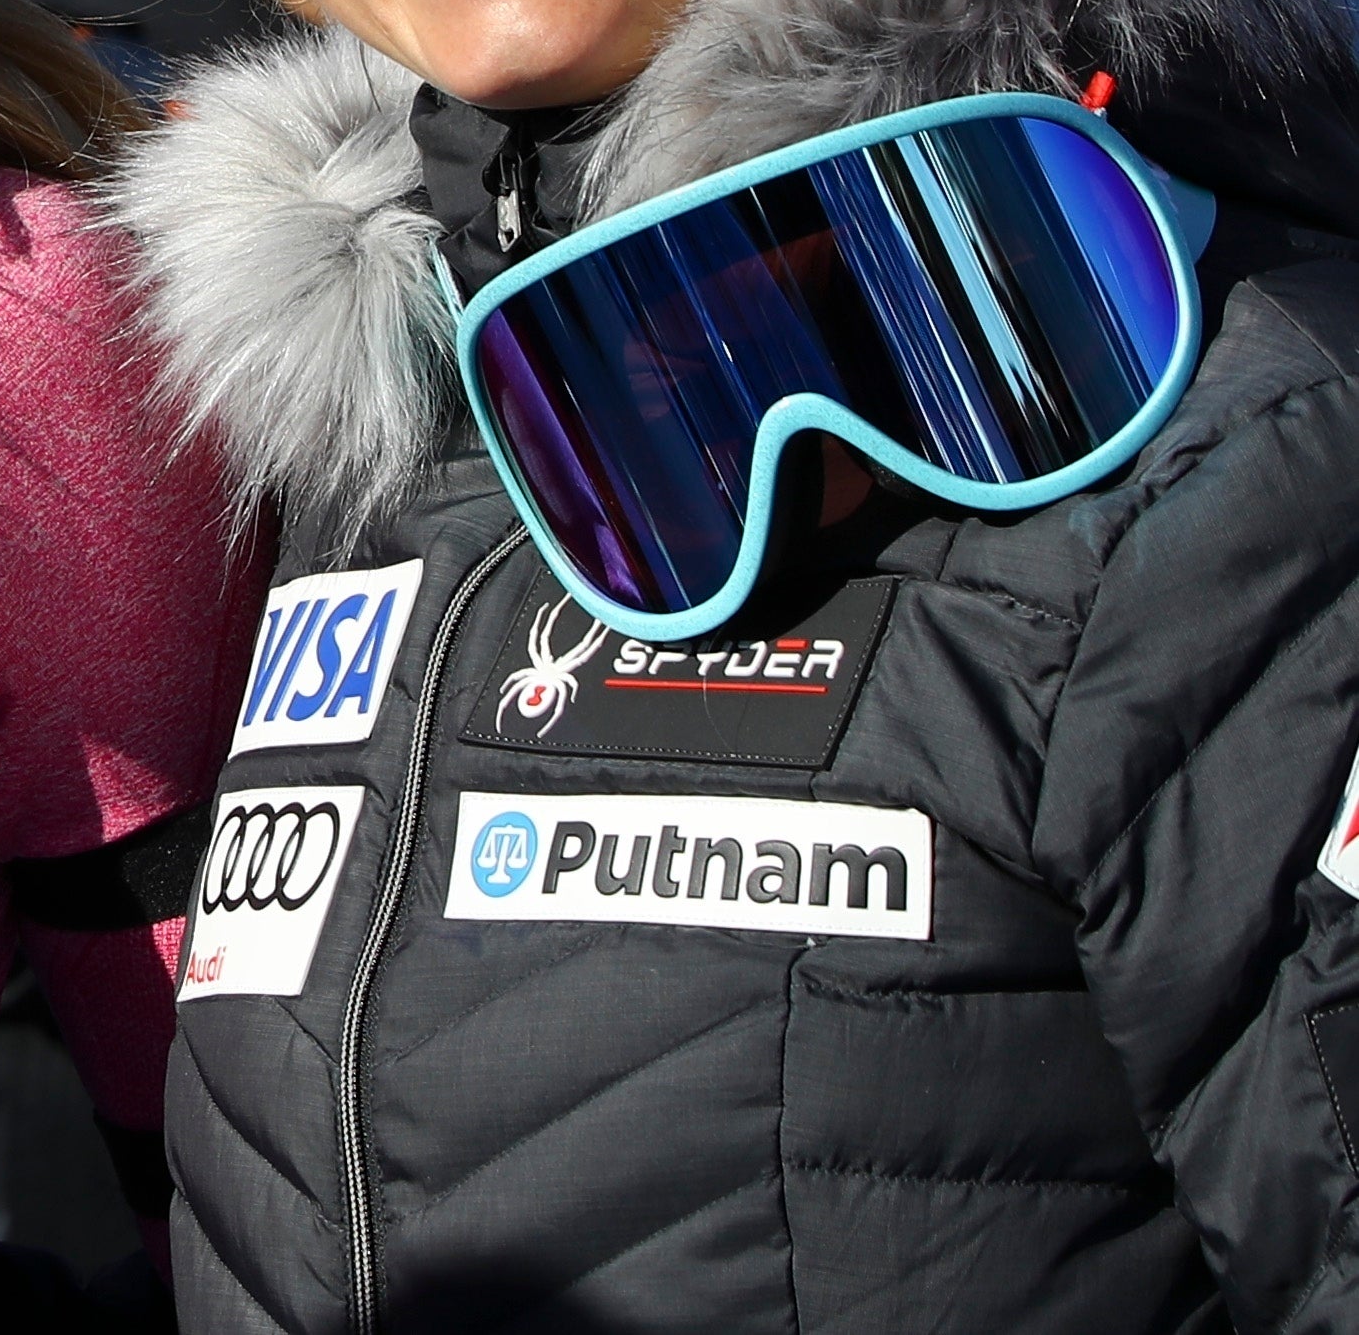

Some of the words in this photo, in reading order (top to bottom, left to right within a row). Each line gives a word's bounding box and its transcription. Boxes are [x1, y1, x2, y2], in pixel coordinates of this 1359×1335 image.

[242, 589, 397, 728] VISA
[613, 639, 844, 679] SPYDER
[541, 821, 907, 912] Putnam
[185, 946, 227, 986] Audi
